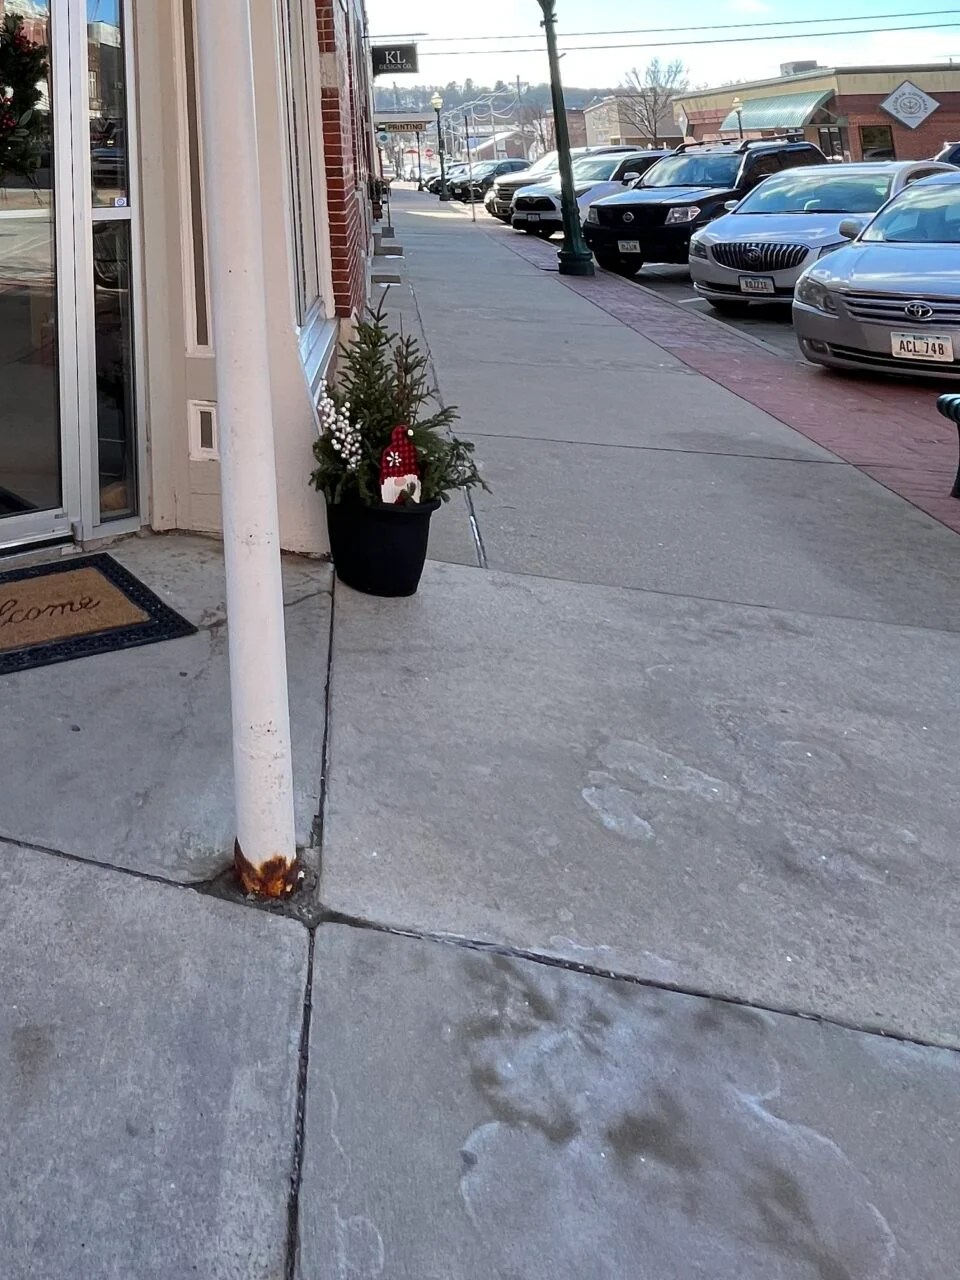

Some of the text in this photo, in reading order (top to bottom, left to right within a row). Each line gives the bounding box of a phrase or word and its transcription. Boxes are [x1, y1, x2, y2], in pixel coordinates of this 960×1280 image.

[384, 50, 406, 64] KL
[387, 123, 423, 131] PRINTING
[899, 340, 920, 354] ACL
